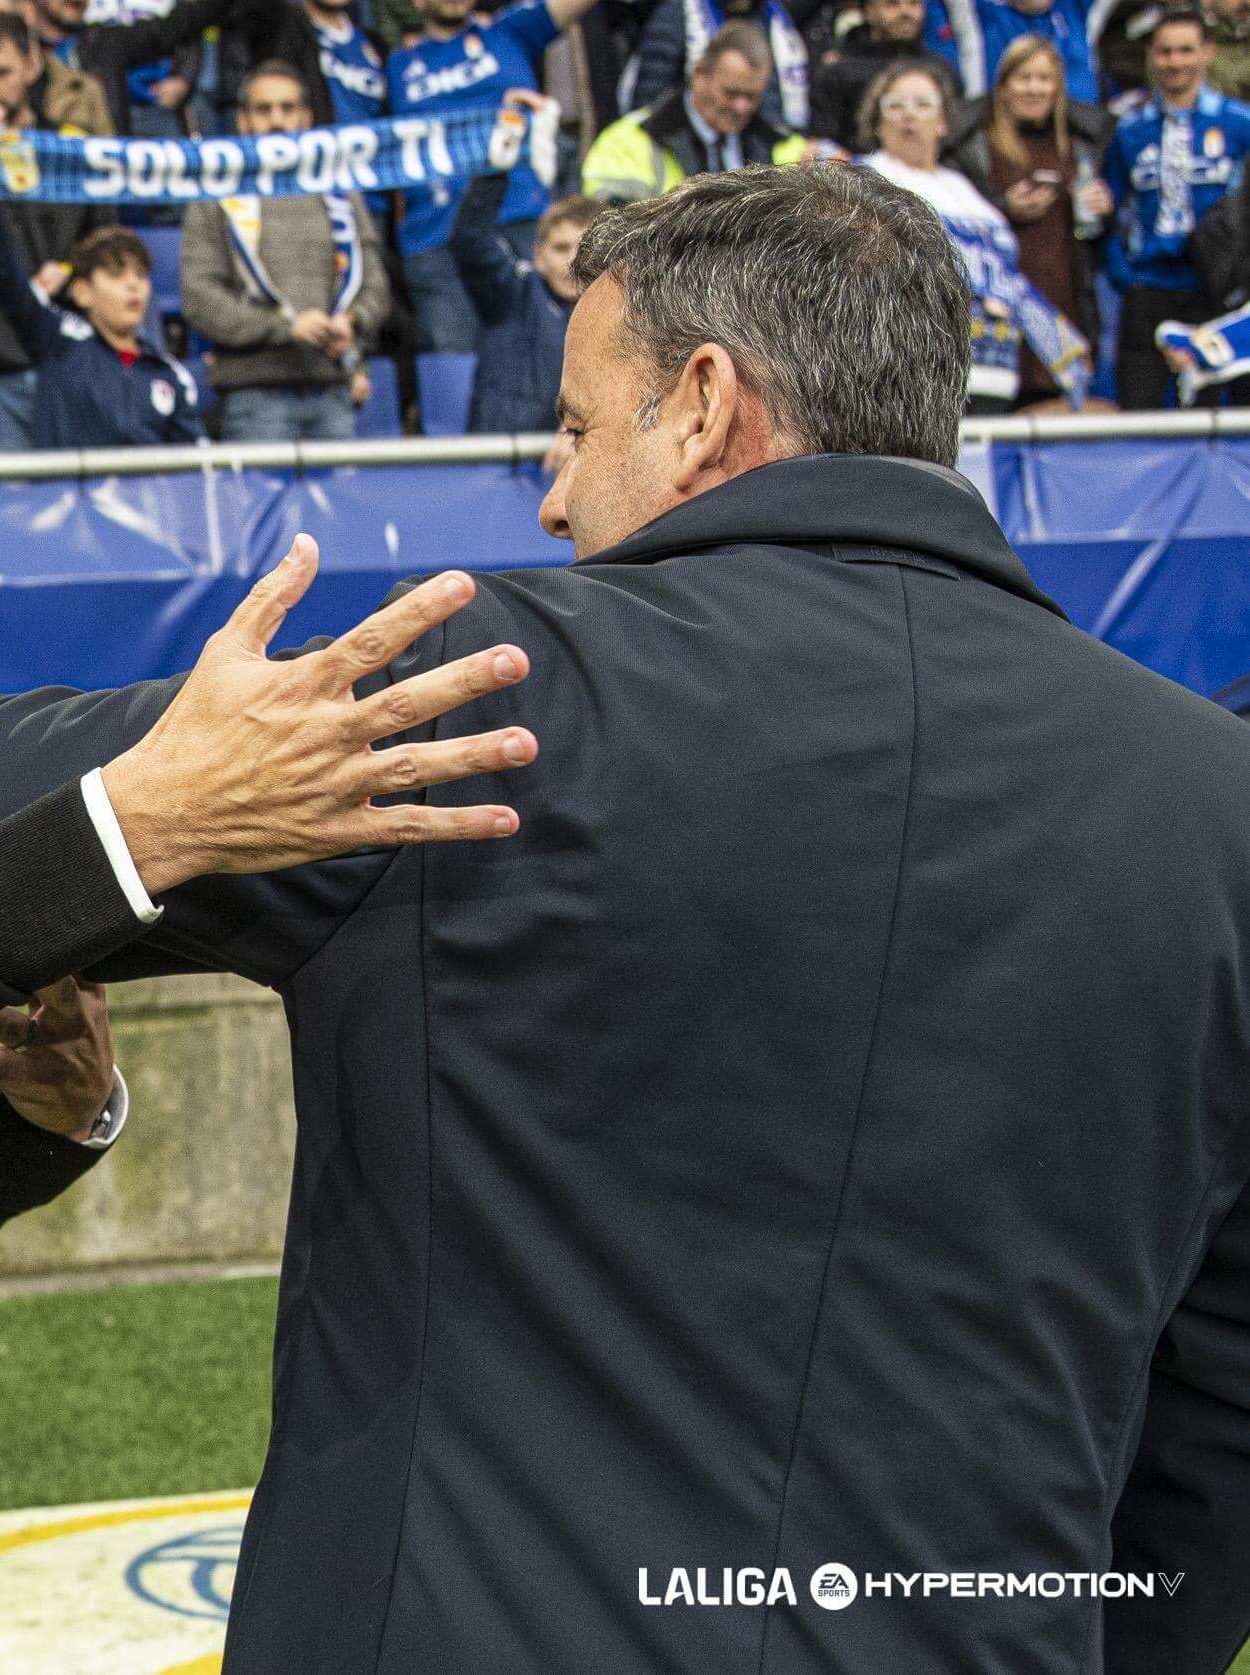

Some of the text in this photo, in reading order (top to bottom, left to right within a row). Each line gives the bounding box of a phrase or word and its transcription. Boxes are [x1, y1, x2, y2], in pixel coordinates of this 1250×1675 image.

[83, 119, 454, 198] SOLO POR TI
